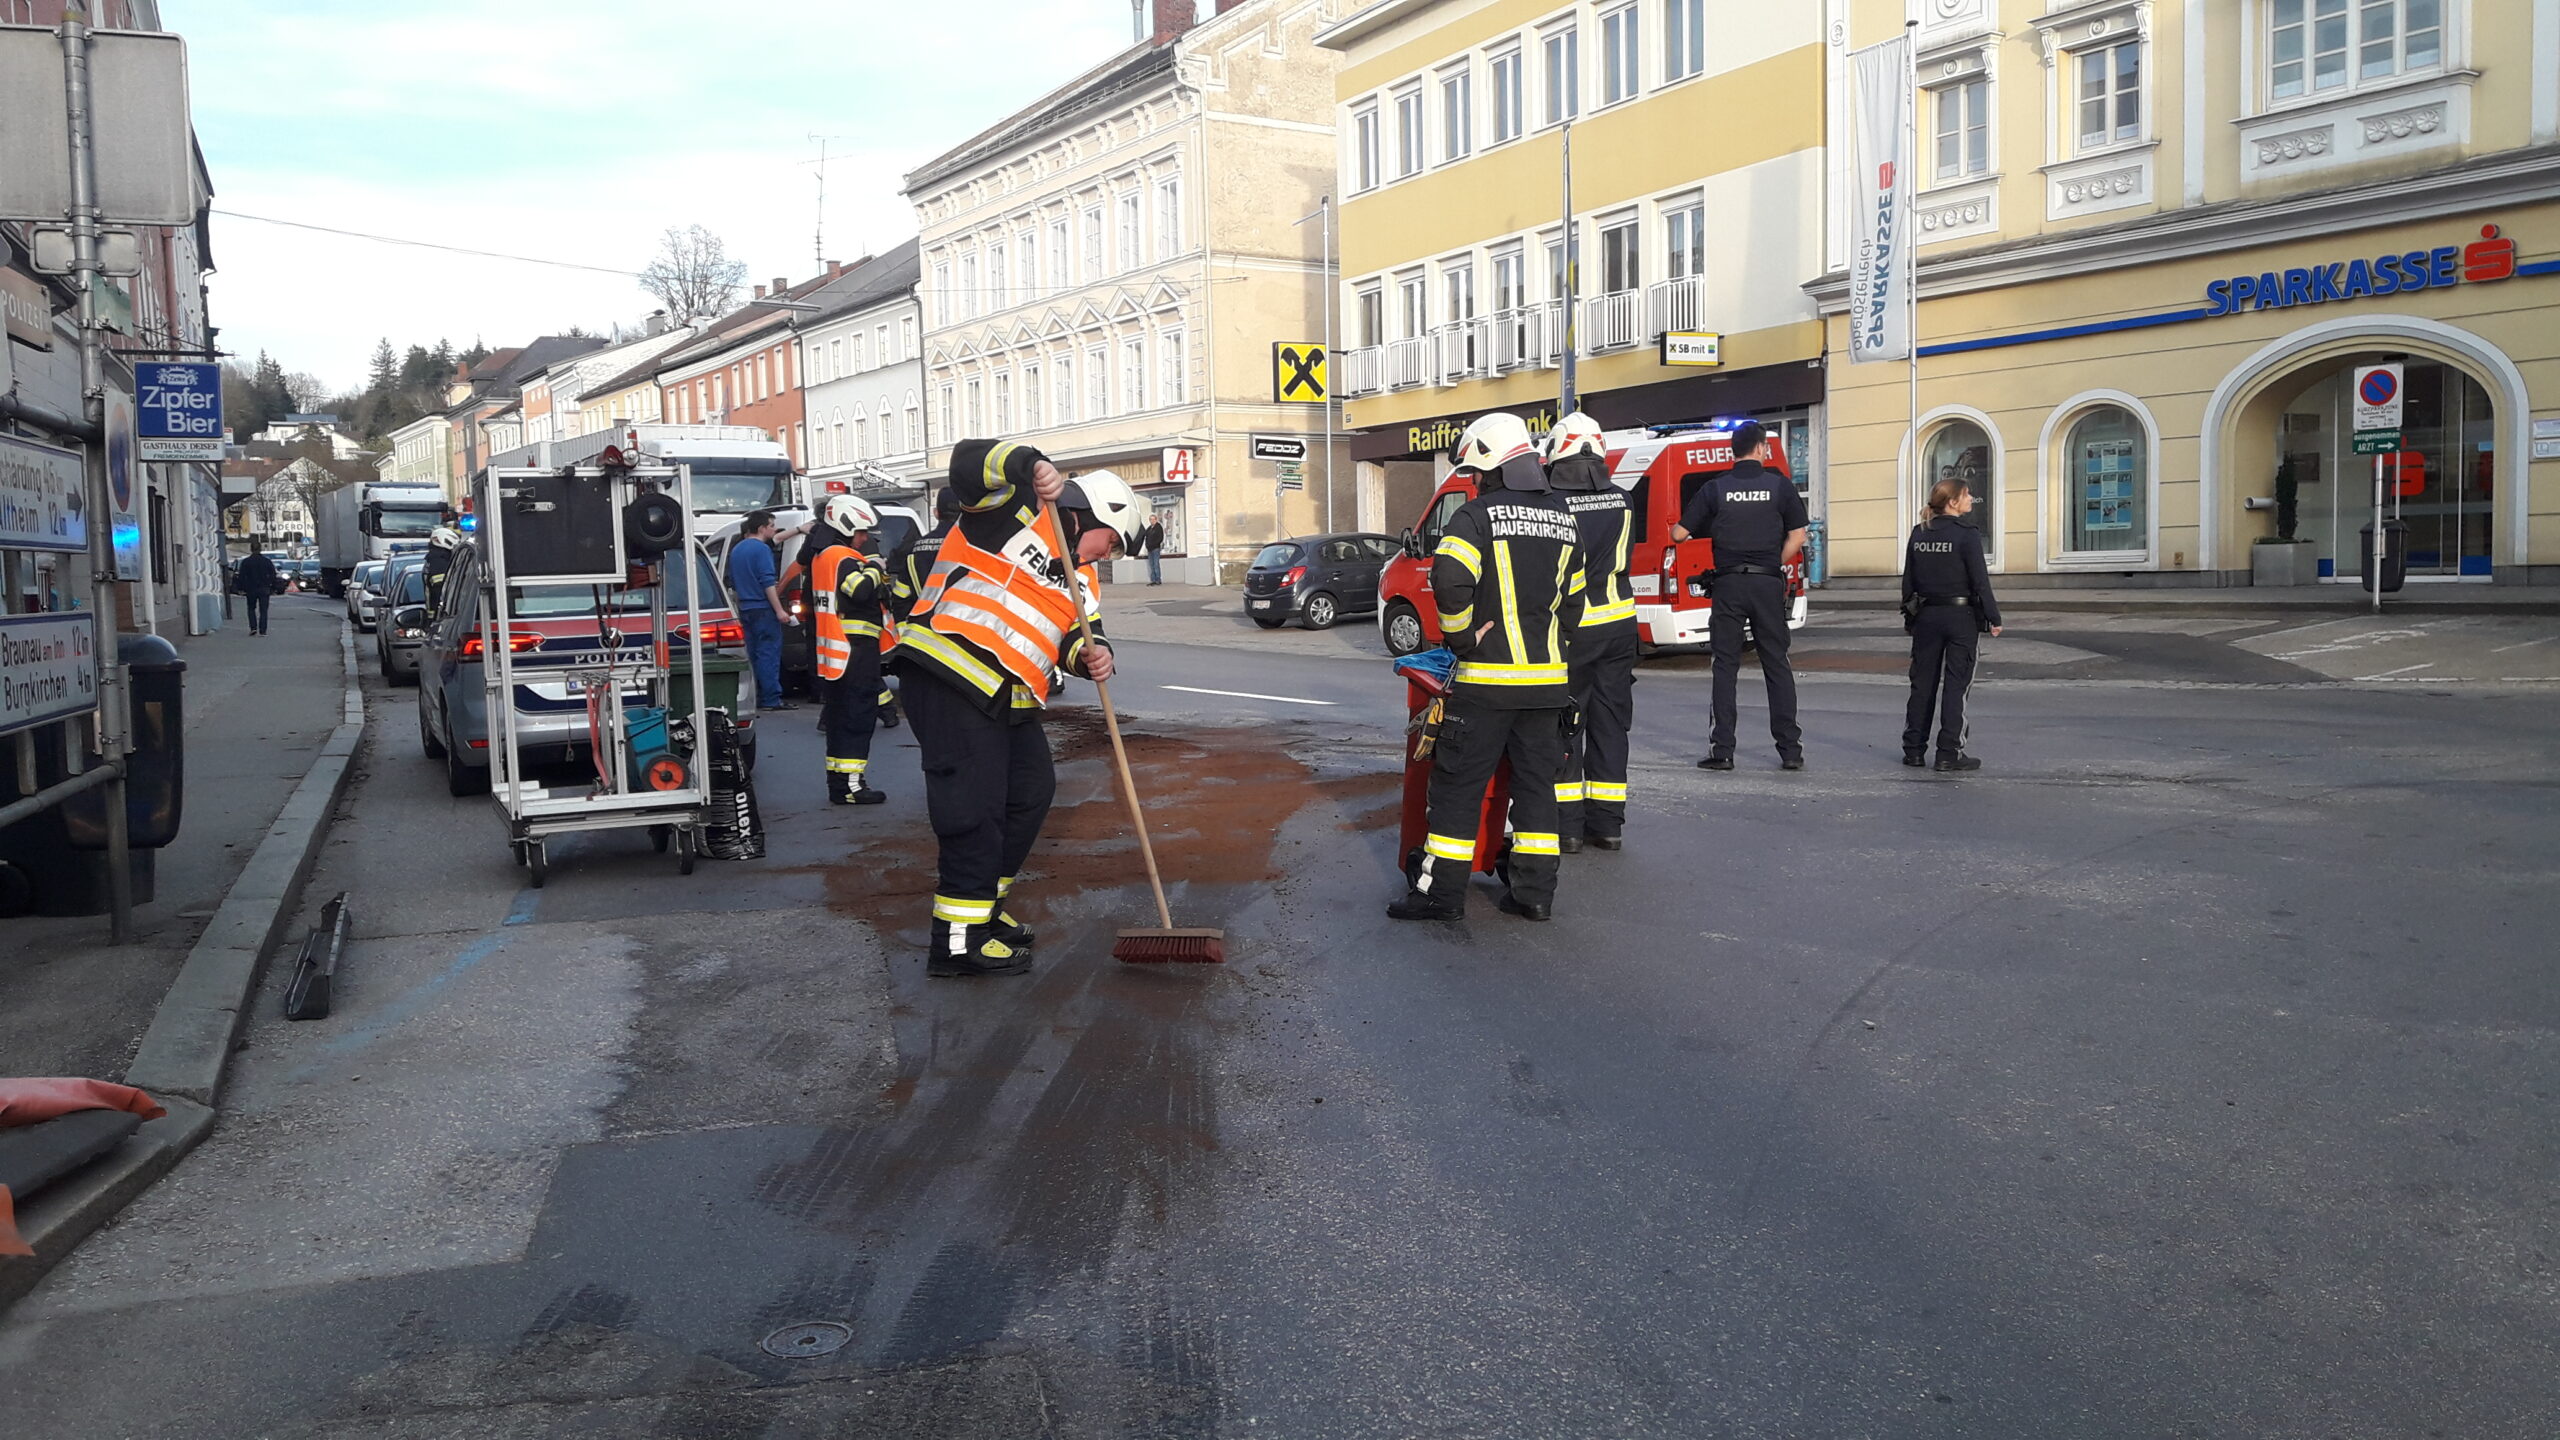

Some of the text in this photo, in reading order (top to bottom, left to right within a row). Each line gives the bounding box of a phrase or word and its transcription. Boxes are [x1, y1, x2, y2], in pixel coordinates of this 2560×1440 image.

[2206, 246, 2458, 317] SPARKASSE
[1678, 343, 1706, 354] SB mit
[142, 385, 215, 411] Zipfer
[167, 411, 217, 433] Bier
[143, 442, 187, 450] GASTHAUS
[1686, 440, 1773, 465] FEUERR
[2357, 442, 2375, 452] ARZT
[1565, 493, 1624, 505] FEUERWEHR
[1568, 500, 1626, 513] MAUERKIRCHEN
[1726, 490, 1770, 502] POLIZEI
[48, 501, 58, 536] 12
[1487, 505, 1575, 527] FEUERWEHR
[1491, 520, 1577, 543] MAUERKIRCHEN
[1914, 541, 1953, 552] POLIZEI
[1, 631, 41, 667] Braunau
[72, 625, 81, 656] 12
[4, 668, 68, 716] Burgkirchen
[77, 663, 84, 693] 4
